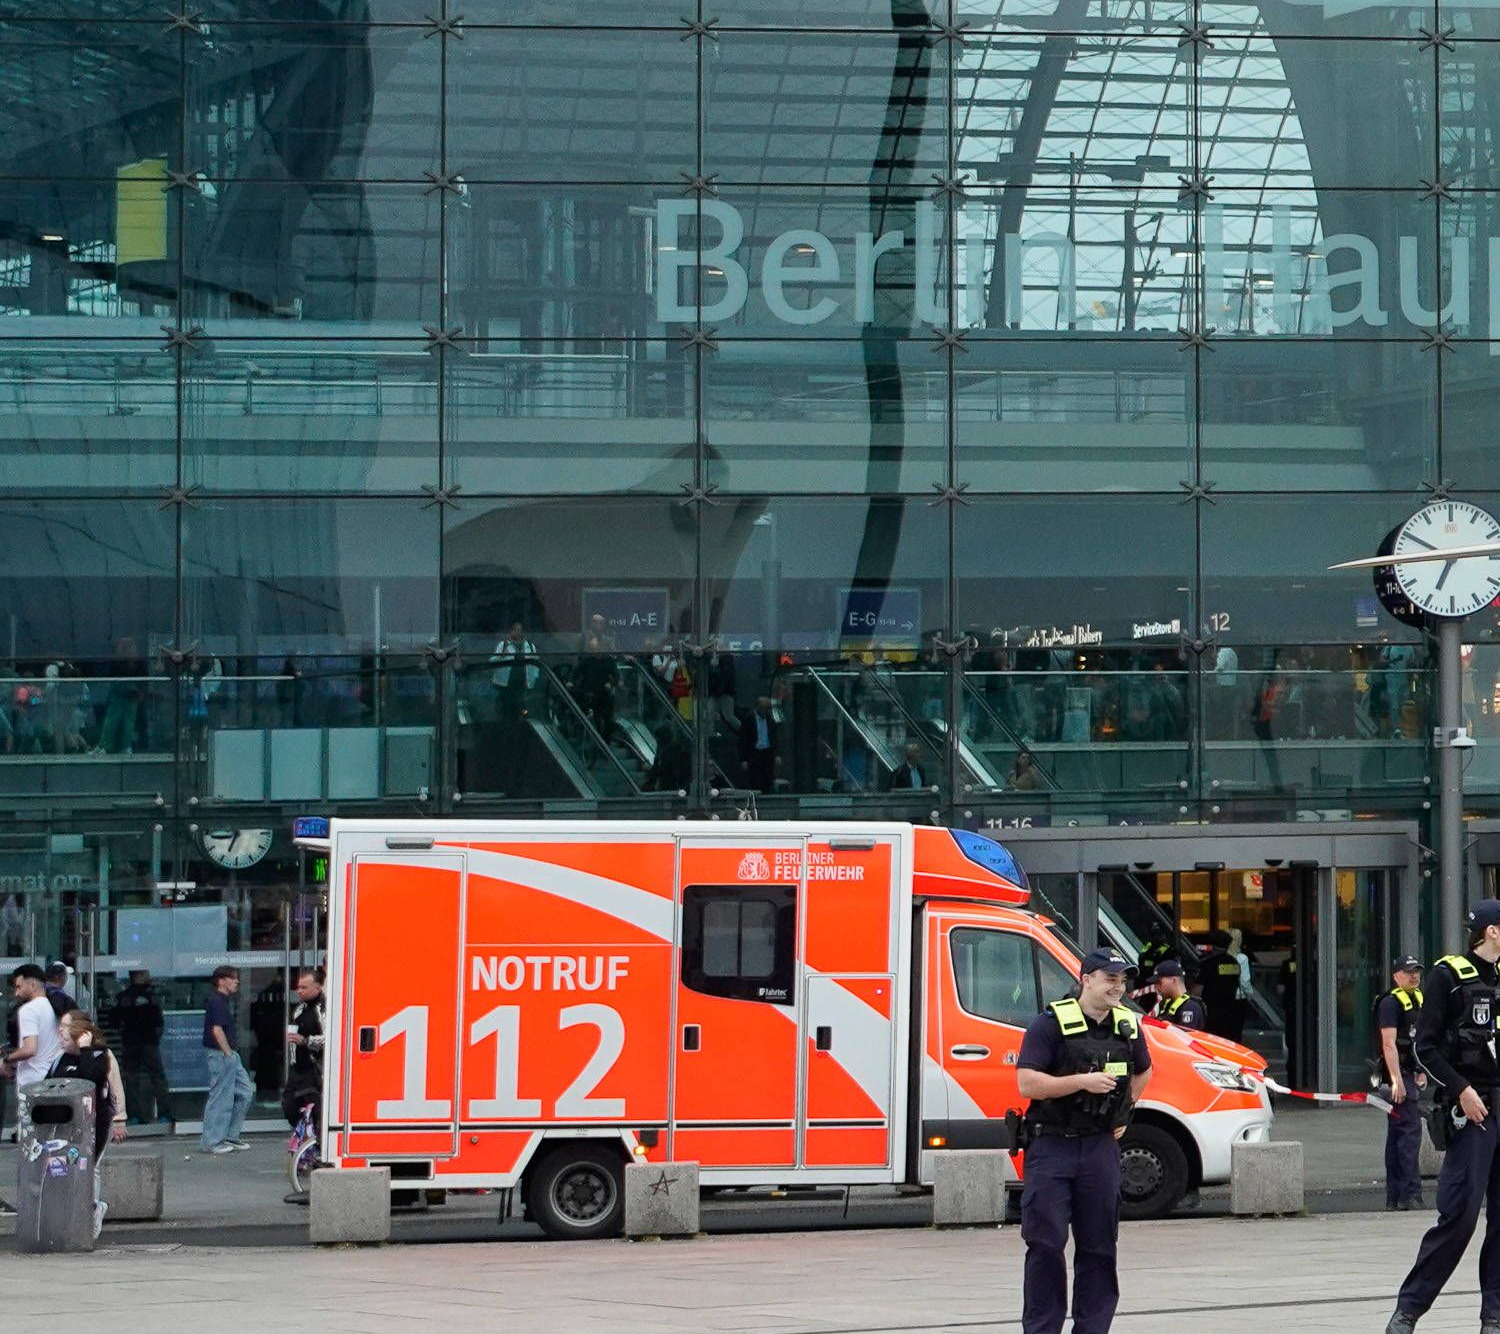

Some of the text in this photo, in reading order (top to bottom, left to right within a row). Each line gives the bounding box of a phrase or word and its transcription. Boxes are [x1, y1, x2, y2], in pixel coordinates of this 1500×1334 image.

[656, 198, 1075, 329] Berlin
[849, 612, 876, 626] E-G
[1210, 612, 1232, 632] 12
[1078, 623, 1103, 645] Bakery
[1133, 621, 1171, 639] ServiceStore
[775, 852, 835, 864] BERLINER
[774, 865, 865, 881] FEUERWEHR
[472, 956, 629, 992] NOTRUF
[376, 1002, 627, 1121] 112
